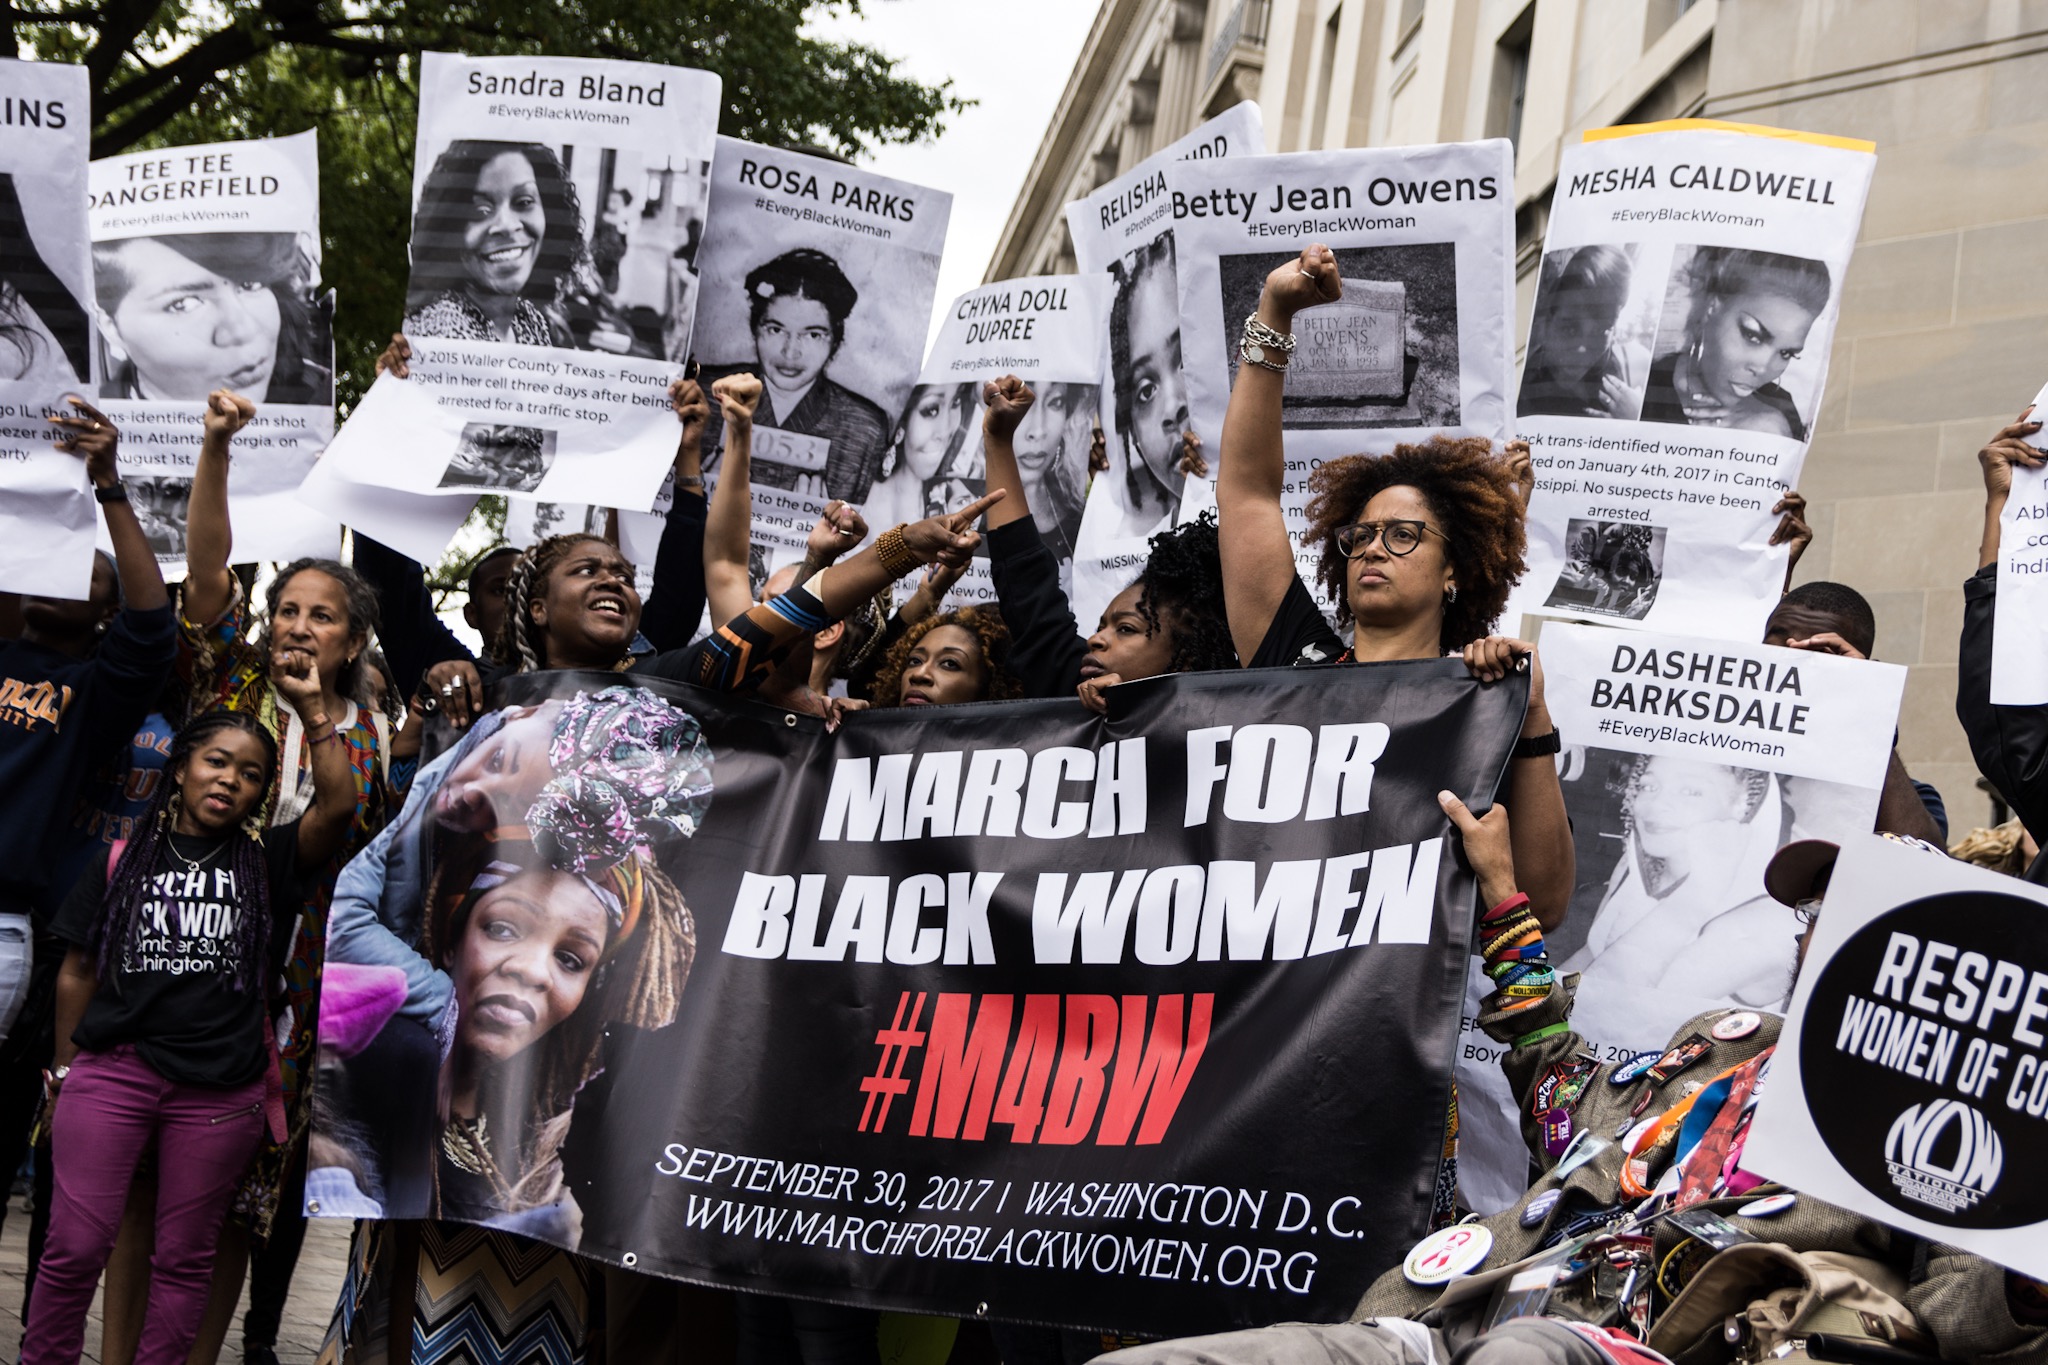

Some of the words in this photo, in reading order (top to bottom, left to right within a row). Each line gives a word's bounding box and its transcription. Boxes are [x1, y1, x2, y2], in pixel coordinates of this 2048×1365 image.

[468, 70, 564, 98] Sandra
[579, 74, 666, 107] Bland
[0, 98, 67, 129] INS
[488, 104, 630, 126] #EveryBlackWoman
[125, 160, 171, 182] TEE
[185, 154, 233, 174] TEE
[739, 158, 819, 201] ROSA
[831, 181, 915, 222] PARKS
[1100, 170, 1167, 230] RELISHA
[1172, 187, 1257, 223] Betty
[1269, 183, 1352, 213] Jean
[1367, 176, 1497, 207] Owens
[1569, 165, 1656, 198] MESHA
[1669, 164, 1835, 205] CALDWELL
[754, 197, 892, 239] #EveryBlackWoman
[1124, 202, 1172, 237] #ProtectBla
[1247, 215, 1416, 238] #EveryBlackWoman
[1611, 208, 1765, 228] #EveryBlackWoman
[957, 290, 1010, 320] CHYNA
[1019, 288, 1068, 311] DOLL
[966, 318, 1035, 344] DUPREE
[1314, 329, 1368, 346] OWENS
[1346, 316, 1377, 328] JEAN
[429, 350, 459, 365] 2015
[461, 353, 504, 367] Waller
[508, 357, 560, 376] County
[564, 363, 606, 379] Texas
[620, 370, 668, 388] Found
[446, 373, 458, 385] in
[461, 374, 482, 387] her
[485, 377, 507, 389] cell
[511, 379, 549, 393] three
[553, 383, 588, 400] days
[591, 389, 627, 403] after
[274, 415, 306, 428] shot
[437, 395, 491, 410] arrested
[495, 397, 513, 411] for
[515, 403, 524, 412] a
[527, 403, 571, 418] traffic
[575, 409, 612, 424] stop.
[278, 437, 298, 448] on
[1547, 434, 1660, 454] trans-identified
[1664, 444, 1724, 460] woman
[1729, 447, 1778, 466] found
[1557, 459, 1575, 470] on
[1578, 458, 1637, 477] January
[1641, 463, 1669, 479] 4th,
[1674, 466, 1710, 481] 2017
[1714, 469, 1728, 483] in
[758, 493, 773, 504] to
[776, 496, 799, 511] the
[1583, 481, 1604, 494] No
[1608, 485, 1674, 501] suspects
[1677, 489, 1715, 505] have
[1720, 493, 1761, 511] been
[766, 515, 793, 528] and
[1587, 506, 1652, 522] arrested.
[1611, 645, 1802, 697] DASHERIA
[1590, 678, 1810, 736] BARKSDALE
[1598, 719, 1785, 757] #EveryBlackWoman
[819, 737, 1146, 842] MARCH
[1184, 722, 1390, 828] FOR
[722, 871, 1005, 966] BLACK
[1032, 837, 1444, 965] WOMEN
[1873, 931, 2048, 1048] RESPE
[1836, 995, 1959, 1086] WOMEN
[1957, 1037, 2009, 1098] OF
[857, 991, 1214, 1147] #M4BW
[1884, 1099, 2003, 1193] NOW
[655, 1143, 859, 1201] SEPTEMBER
[864, 1170, 907, 1214] 30,
[919, 1175, 994, 1213] 2017
[1024, 1181, 1268, 1229] WASHINGTON
[1887, 1164, 1978, 1201] NATIONAL
[1892, 1175, 1968, 1206] ORGANIZATION
[1901, 1186, 1919, 1197] FOR
[685, 1194, 1318, 1293] WWW.MARCHFORBLACKWOMEN.ORG
